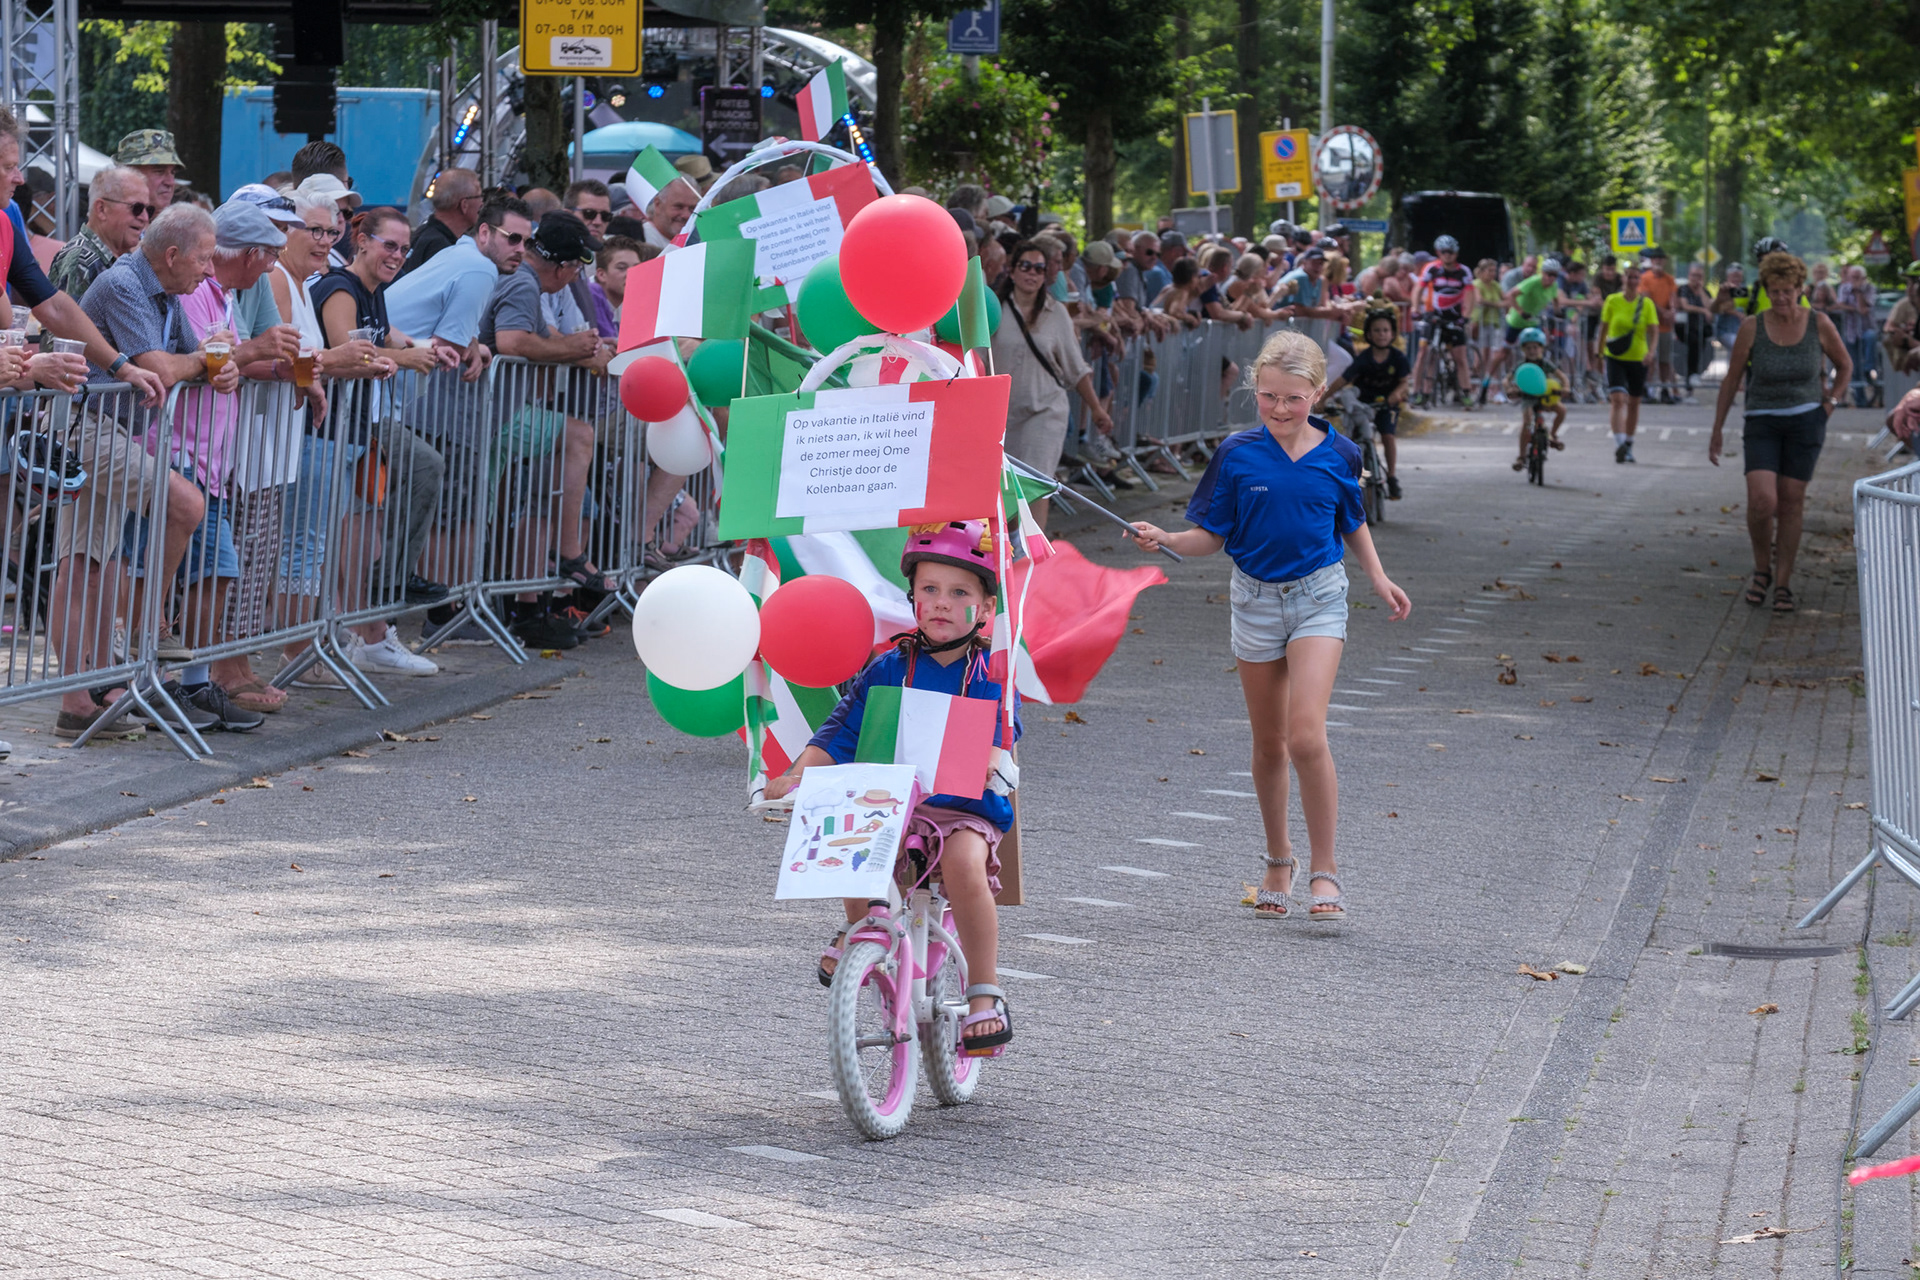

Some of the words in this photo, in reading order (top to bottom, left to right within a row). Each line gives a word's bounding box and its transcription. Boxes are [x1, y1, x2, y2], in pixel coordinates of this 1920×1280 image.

[571, 10, 594, 20] T/M
[535, 24, 574, 34] 07-08
[582, 25, 624, 35] 17.00H
[716, 99, 750, 108] FRITES
[746, 226, 757, 234] Op
[759, 216, 788, 230] vakantie
[797, 209, 815, 218] Italië
[816, 203, 831, 212] vind
[760, 231, 778, 240] niets
[780, 226, 795, 235] aan,
[804, 219, 814, 228] wil
[815, 215, 831, 224] heel
[771, 238, 792, 249] zomer
[794, 232, 812, 243] meej
[812, 226, 830, 236] Ome
[770, 248, 798, 260] Christje
[800, 242, 815, 252] door
[817, 239, 826, 247] de
[772, 255, 810, 271] Kolenbaan
[811, 249, 831, 260] gaan.
[793, 419, 809, 430] Op
[811, 417, 857, 427] vakantie
[860, 415, 870, 424] in
[872, 412, 899, 423] Italië
[901, 411, 925, 421] vind
[796, 436, 805, 445] ik
[807, 434, 834, 444] niets
[836, 433, 860, 442] aan,
[863, 431, 873, 440] ik
[875, 429, 891, 439] wil
[893, 428, 918, 437] heel
[800, 452, 814, 462] de
[816, 450, 850, 460] zomer
[852, 446, 881, 459] meej
[883, 446, 910, 456] Ome
[810, 466, 852, 478] Christje
[855, 465, 881, 475] door
[883, 463, 897, 473] de
[806, 484, 865, 495] Kolenbaan
[867, 482, 897, 493] gaan.
